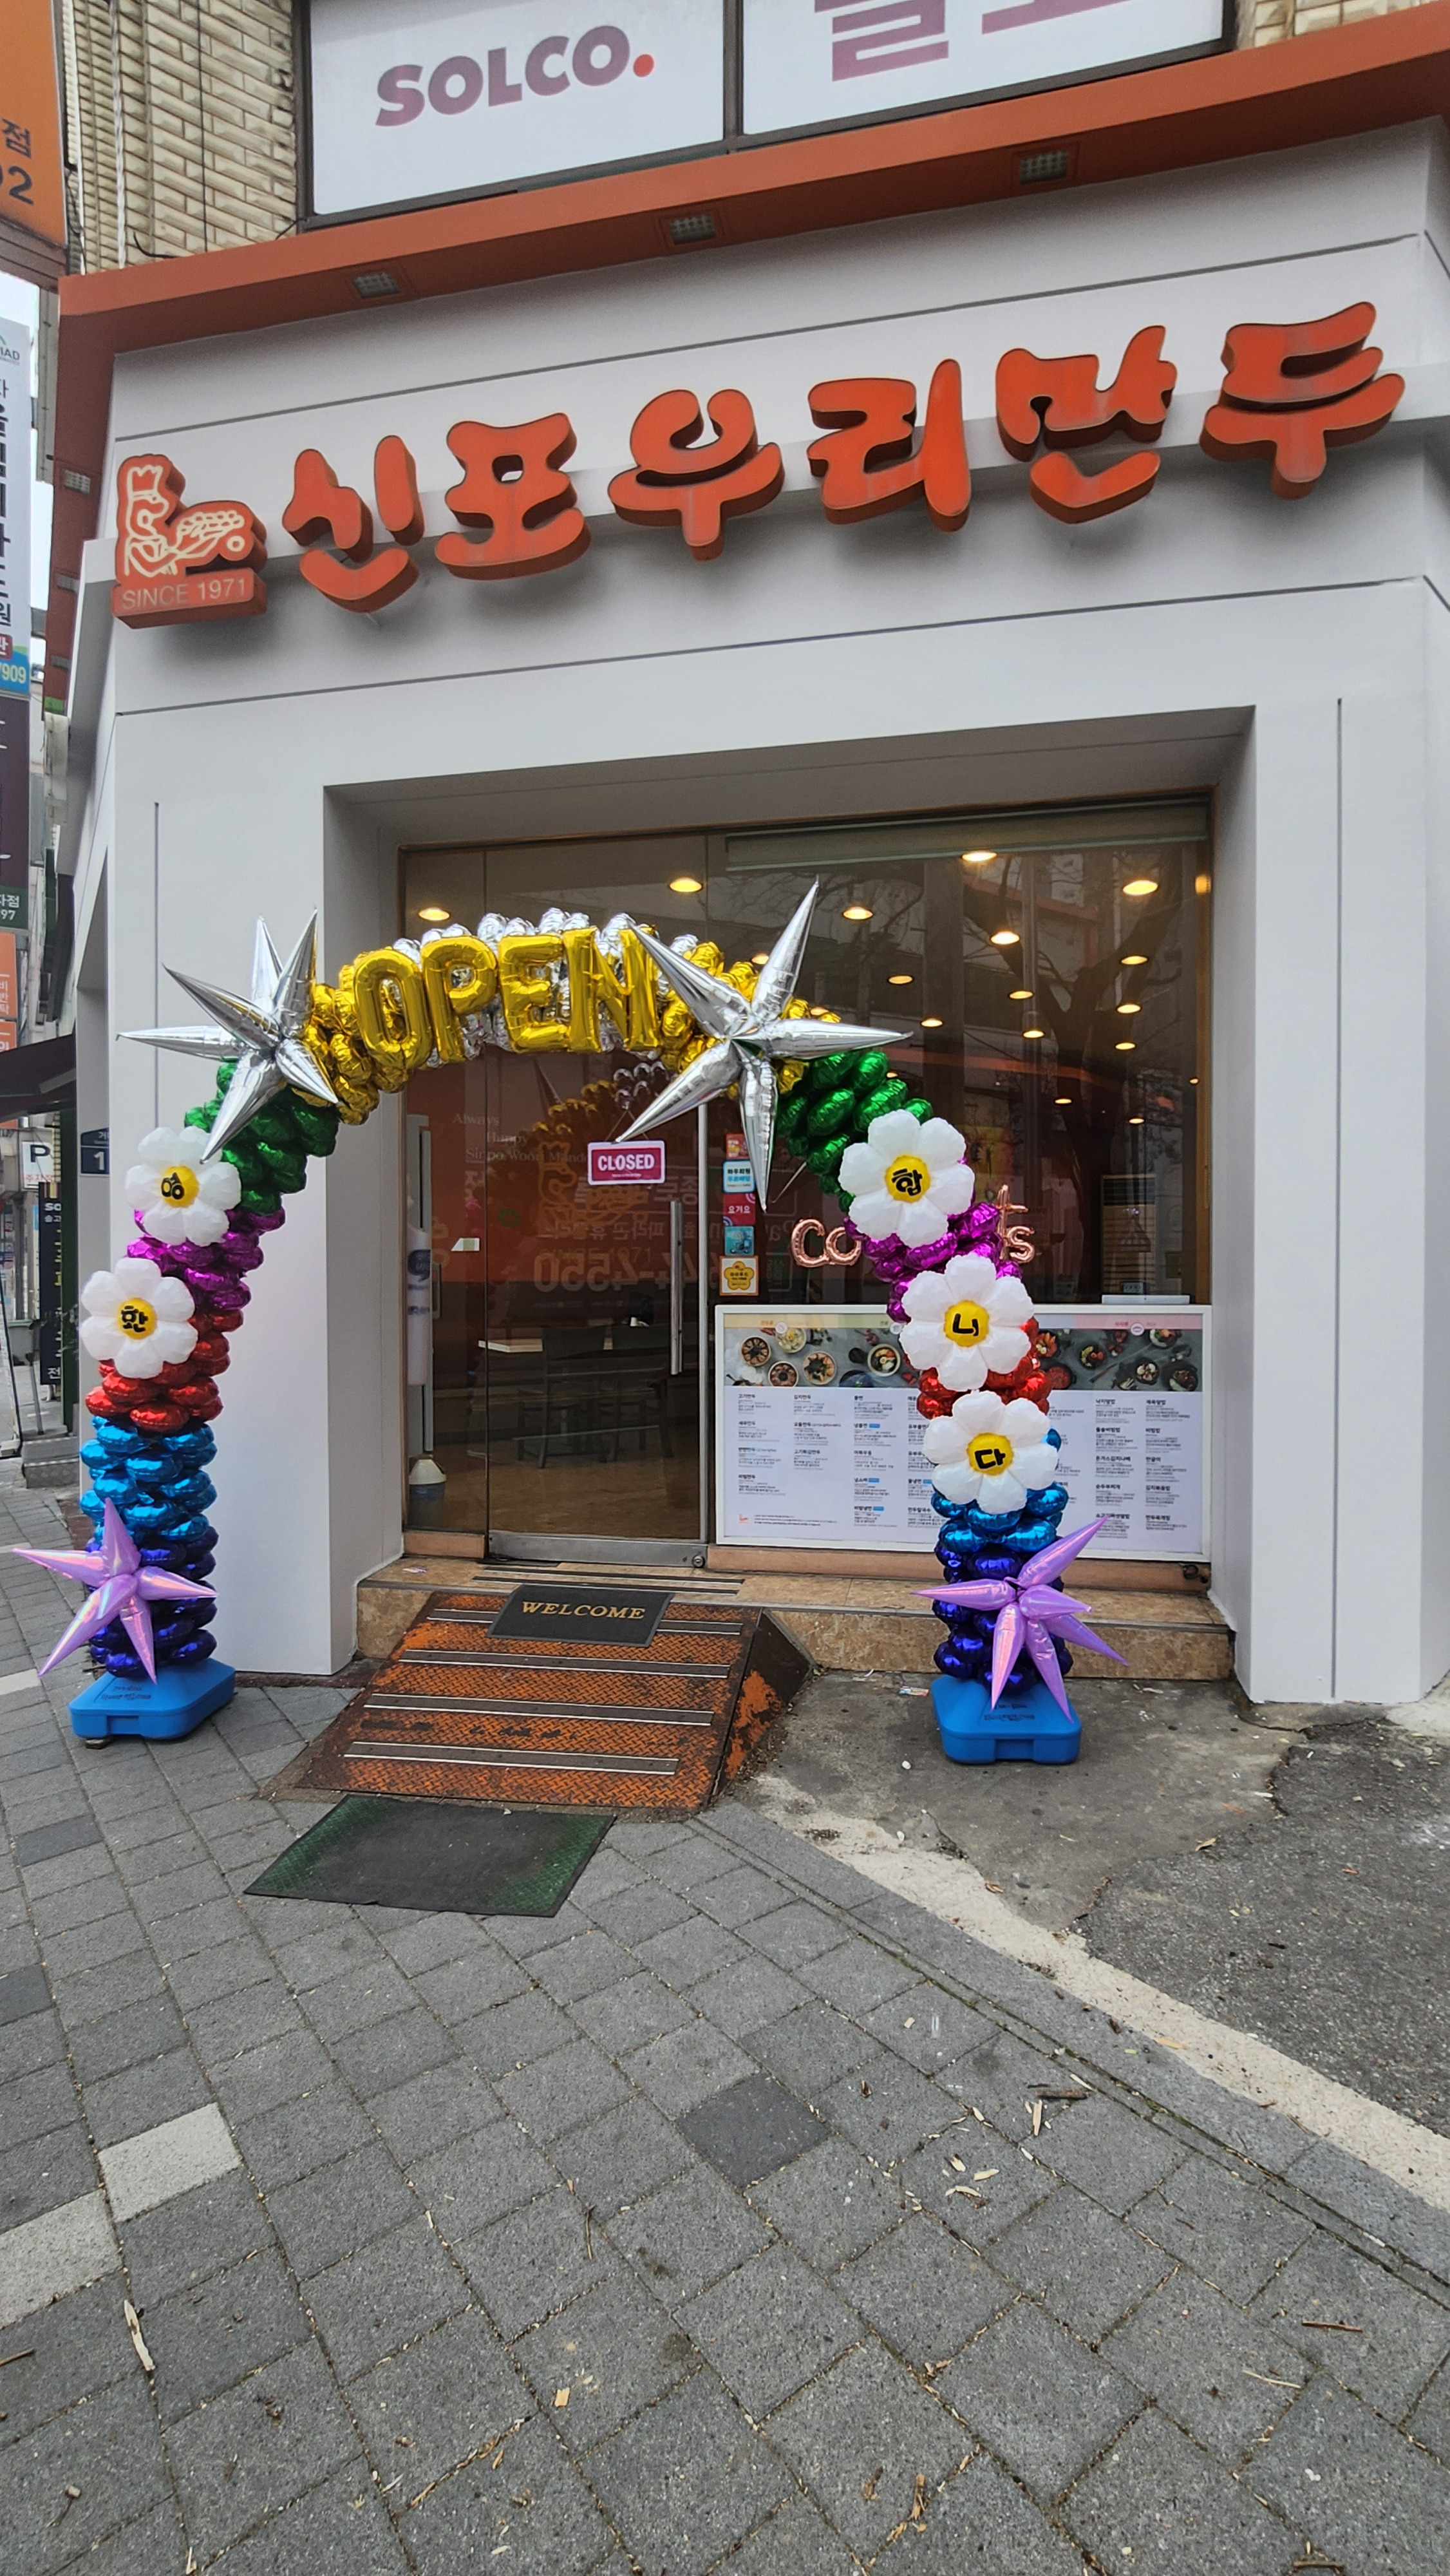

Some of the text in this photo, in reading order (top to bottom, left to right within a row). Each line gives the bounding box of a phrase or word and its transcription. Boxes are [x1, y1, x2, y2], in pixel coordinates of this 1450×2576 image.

[0, 164, 33, 205] 2
[282, 300, 1406, 609] 신포우리만두
[121, 578, 246, 611] SINCE 1971
[355, 925, 661, 1066] OPEN
[30, 1144, 50, 1163] P
[598, 1153, 655, 1171] CLOSED
[161, 1172, 185, 1200] 영
[892, 1170, 923, 1196] 합
[121, 1305, 149, 1332] 환
[953, 1313, 980, 1336] 니
[974, 1448, 1006, 1470] 다
[522, 1601, 645, 1620] WELCOME
